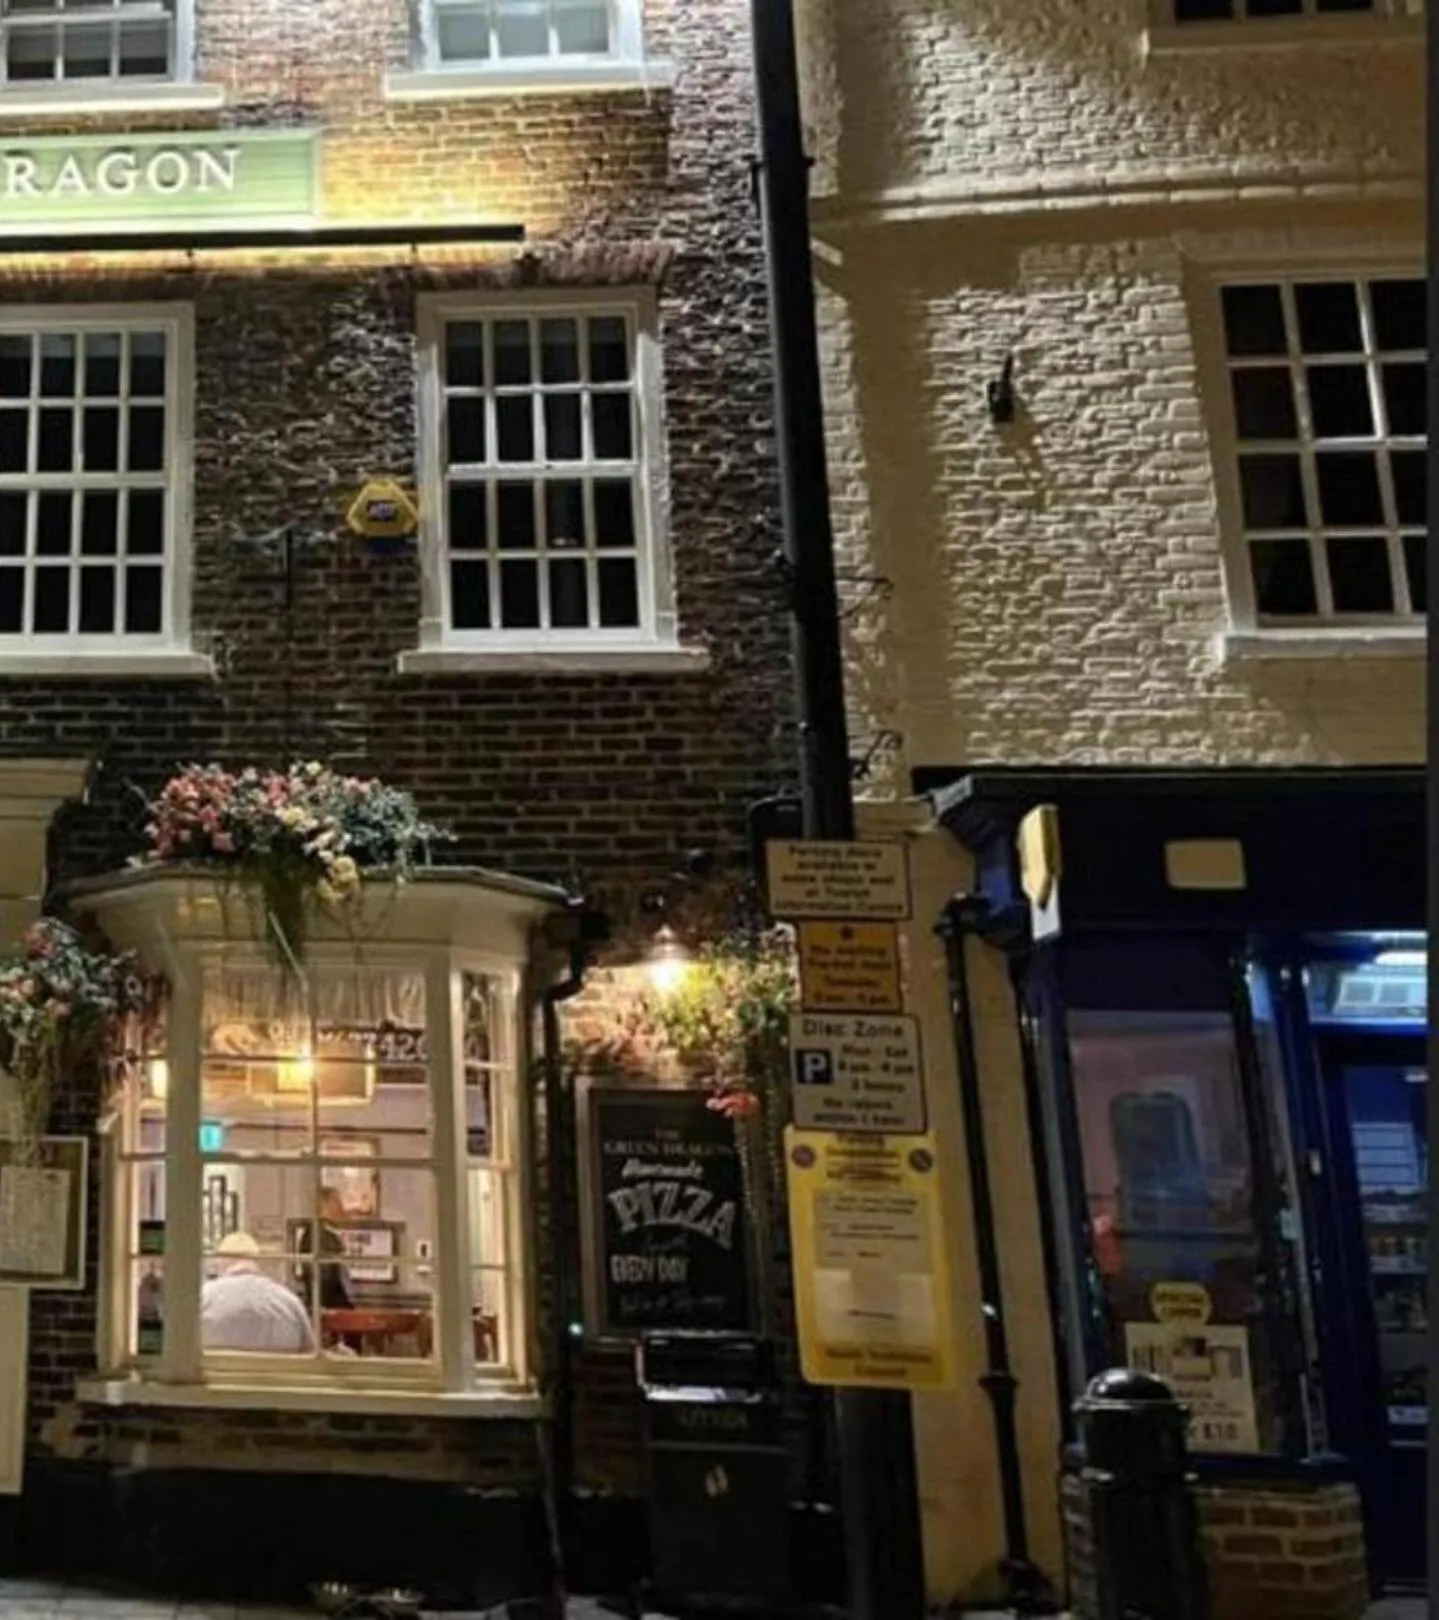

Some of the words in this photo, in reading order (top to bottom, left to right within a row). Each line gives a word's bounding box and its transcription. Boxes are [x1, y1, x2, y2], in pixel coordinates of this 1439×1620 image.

[803, 1018, 845, 1036] Disc
[854, 1020, 903, 1037] Zone
[803, 1053, 828, 1082] P
[608, 1181, 736, 1250] PIZZA
